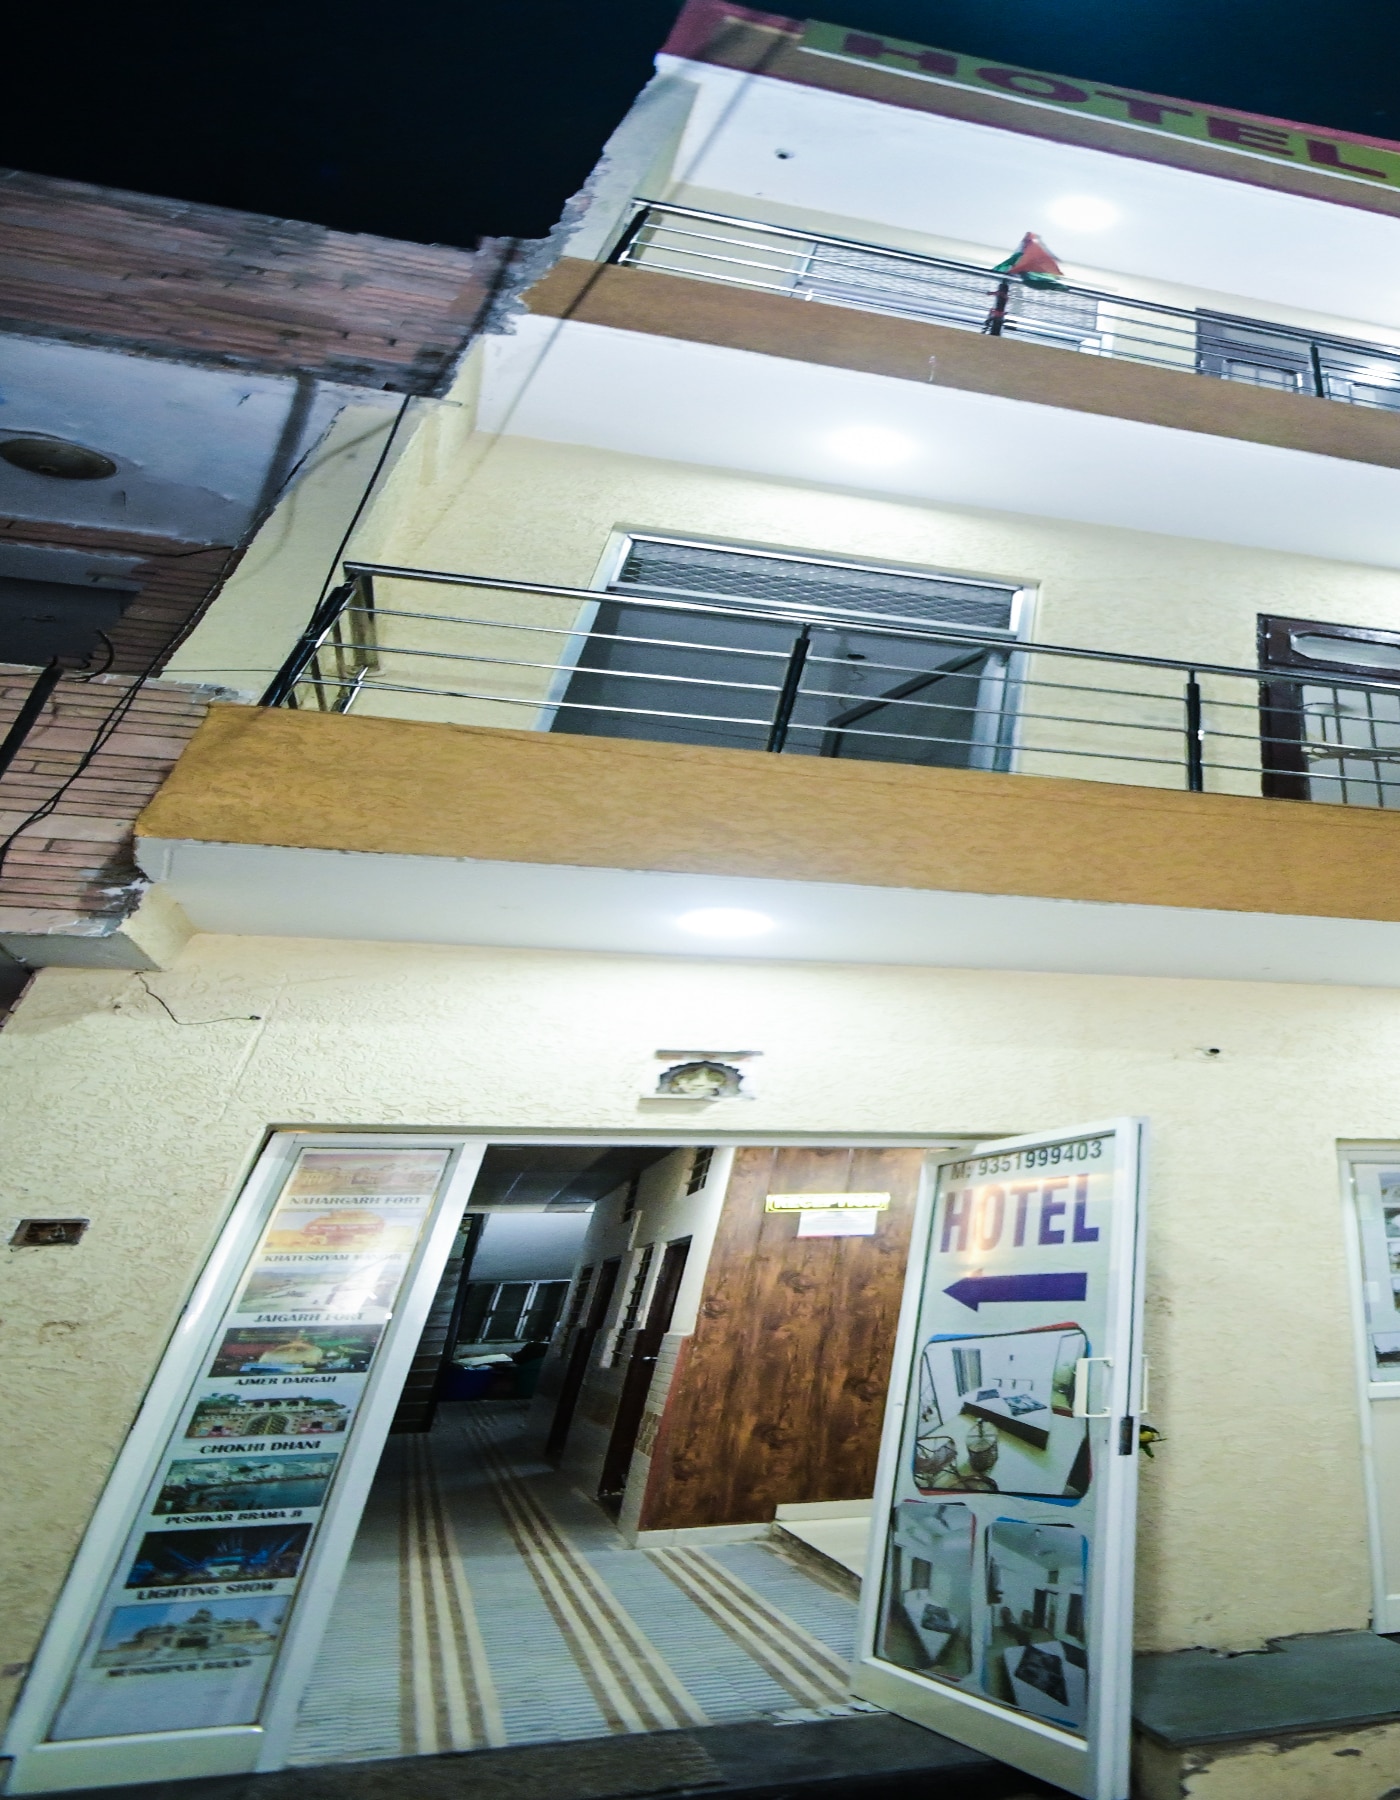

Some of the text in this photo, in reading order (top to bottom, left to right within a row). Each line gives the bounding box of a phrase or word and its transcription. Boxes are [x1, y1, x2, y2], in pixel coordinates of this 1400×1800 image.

[842, 32, 1388, 178] HOTEL
[977, 1140, 1103, 1176] 9351999403
[289, 1196, 422, 1205] NAHARGARH FORT
[939, 1173, 1100, 1253] HOTEL
[254, 1313, 322, 1323] JAIGARH
[234, 1375, 337, 1386] AJMER DARGAH
[199, 1440, 321, 1455] CHOKHI DHANI
[165, 1512, 234, 1525] PUSHKAR
[136, 1581, 279, 1601] LIGHTING SHOW
